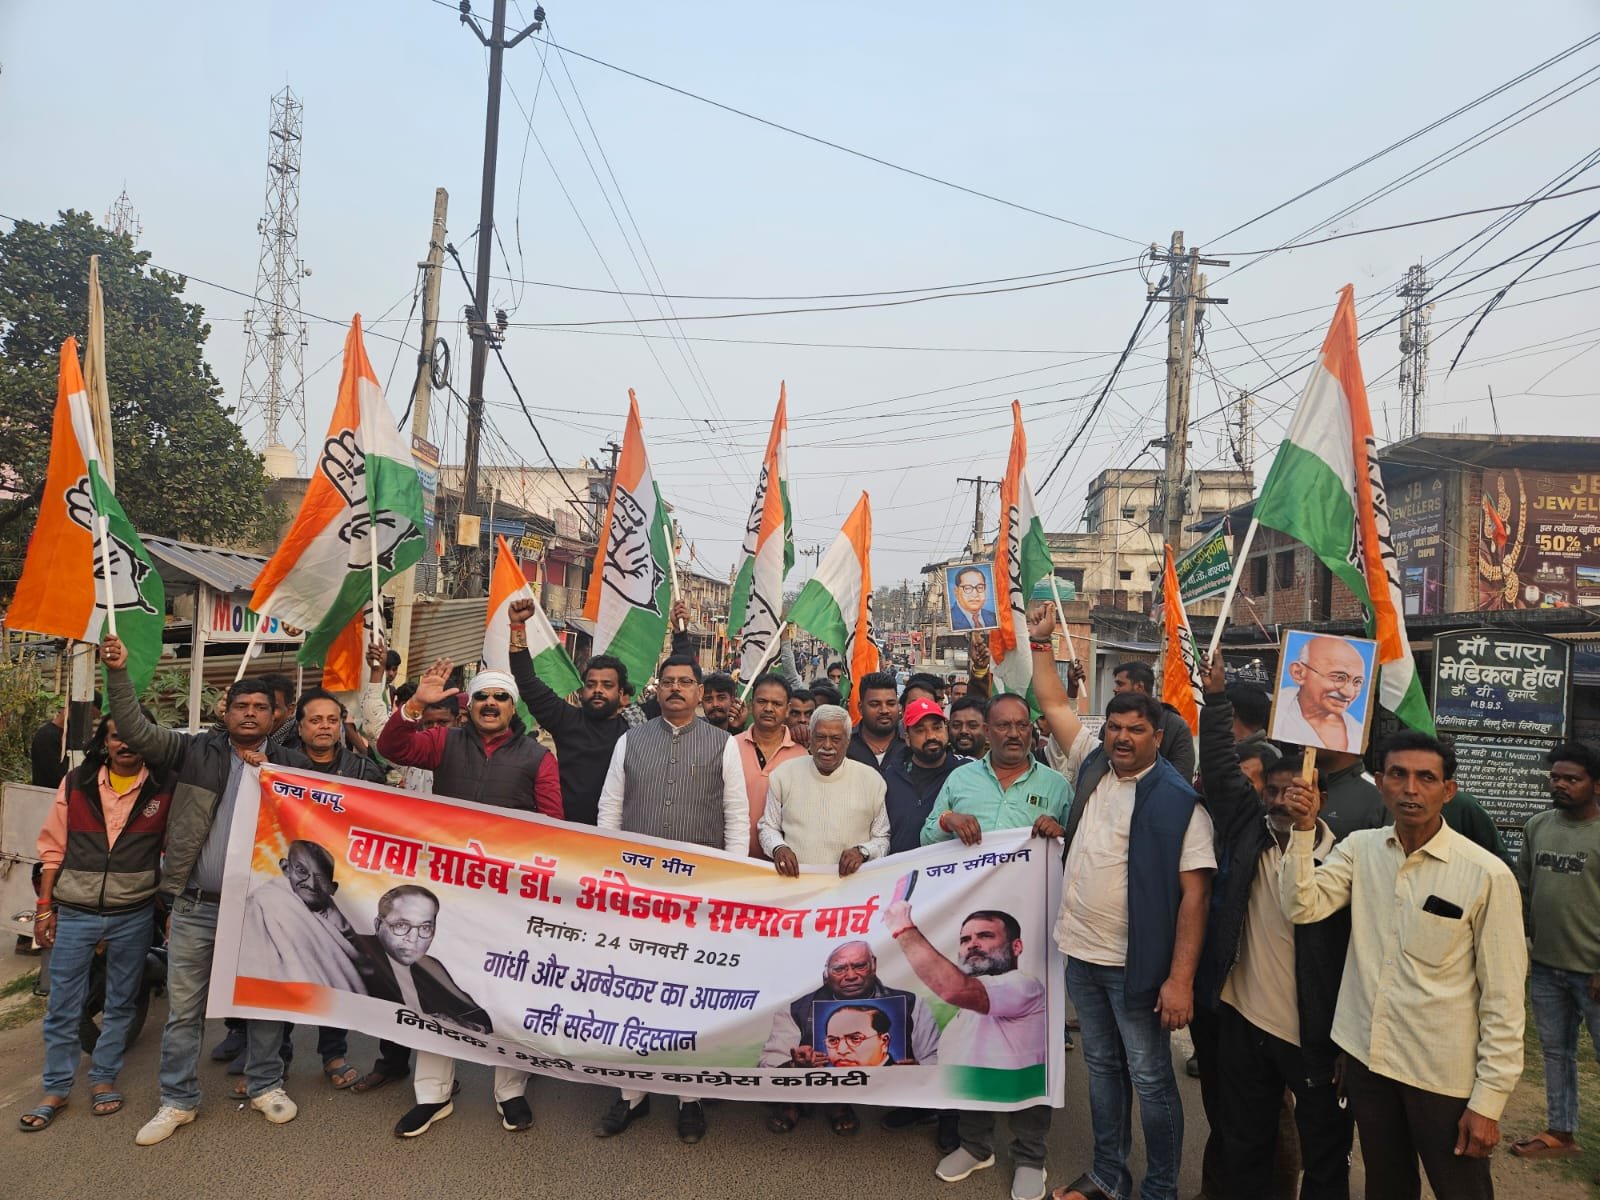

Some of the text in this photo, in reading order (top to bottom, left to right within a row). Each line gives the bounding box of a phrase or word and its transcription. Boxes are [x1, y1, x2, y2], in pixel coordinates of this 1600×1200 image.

[1405, 481, 1422, 502] JB
[1532, 496, 1600, 511] JEWEL
[1540, 534, 1581, 551] 50%
[1494, 641, 1551, 662] तारा
[1439, 656, 1563, 690] मेडिकल हॉल
[1507, 689, 1538, 702] कुमार
[274, 781, 344, 811] जय बापू
[622, 852, 695, 876] जय भीम
[926, 848, 1032, 877] जय संविधान
[349, 829, 879, 938] बाबा साहेब डॉ. अंबेडकर सम्मान मार्च
[526, 916, 741, 967] दिनांक: 24 जनवरी 2025
[483, 949, 760, 1011] गांधी और अम्बेडकर का अपमान
[523, 1003, 697, 1056] नहीं सहेगा हिंदुस्तान
[395, 1008, 488, 1048] निवेदक
[582, 1064, 656, 1081] नगर
[661, 1070, 762, 1087] कांग्रेस
[770, 1070, 870, 1088] कमिटी
